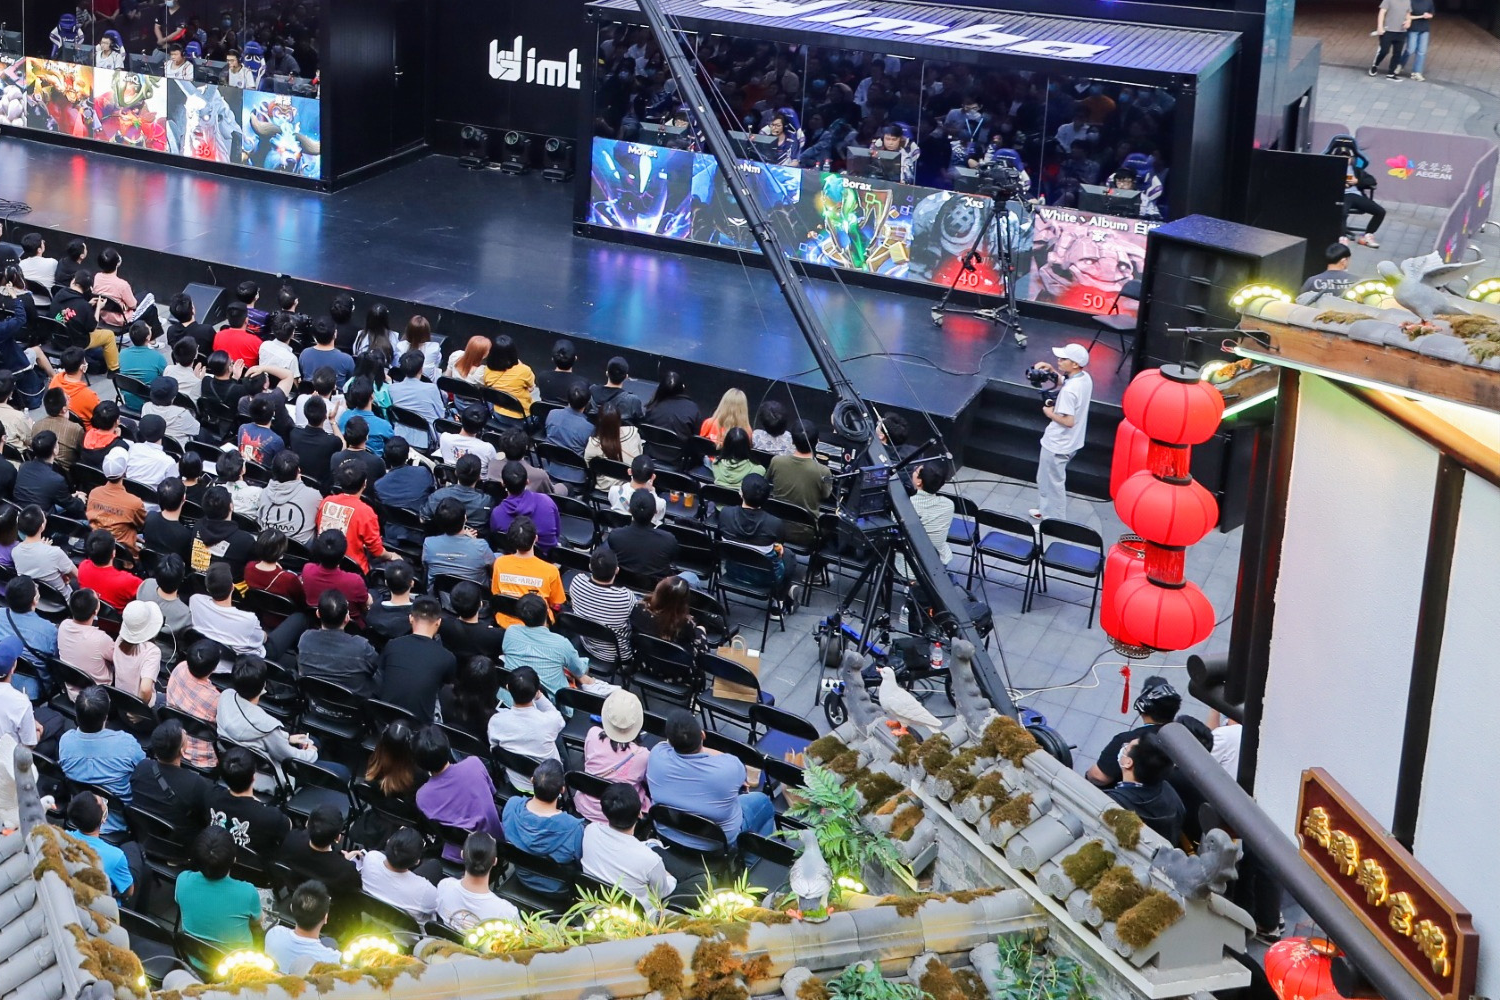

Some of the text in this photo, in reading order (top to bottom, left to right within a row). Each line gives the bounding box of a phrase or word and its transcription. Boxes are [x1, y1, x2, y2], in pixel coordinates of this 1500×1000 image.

[628, 145, 658, 159] Monet
[1416, 160, 1454, 173] 爱琴海
[1415, 170, 1453, 181] AEGEAN
[843, 178, 873, 192] Borax
[965, 196, 984, 209] Xxs
[957, 272, 979, 287] 40
[1083, 293, 1104, 309] 50
